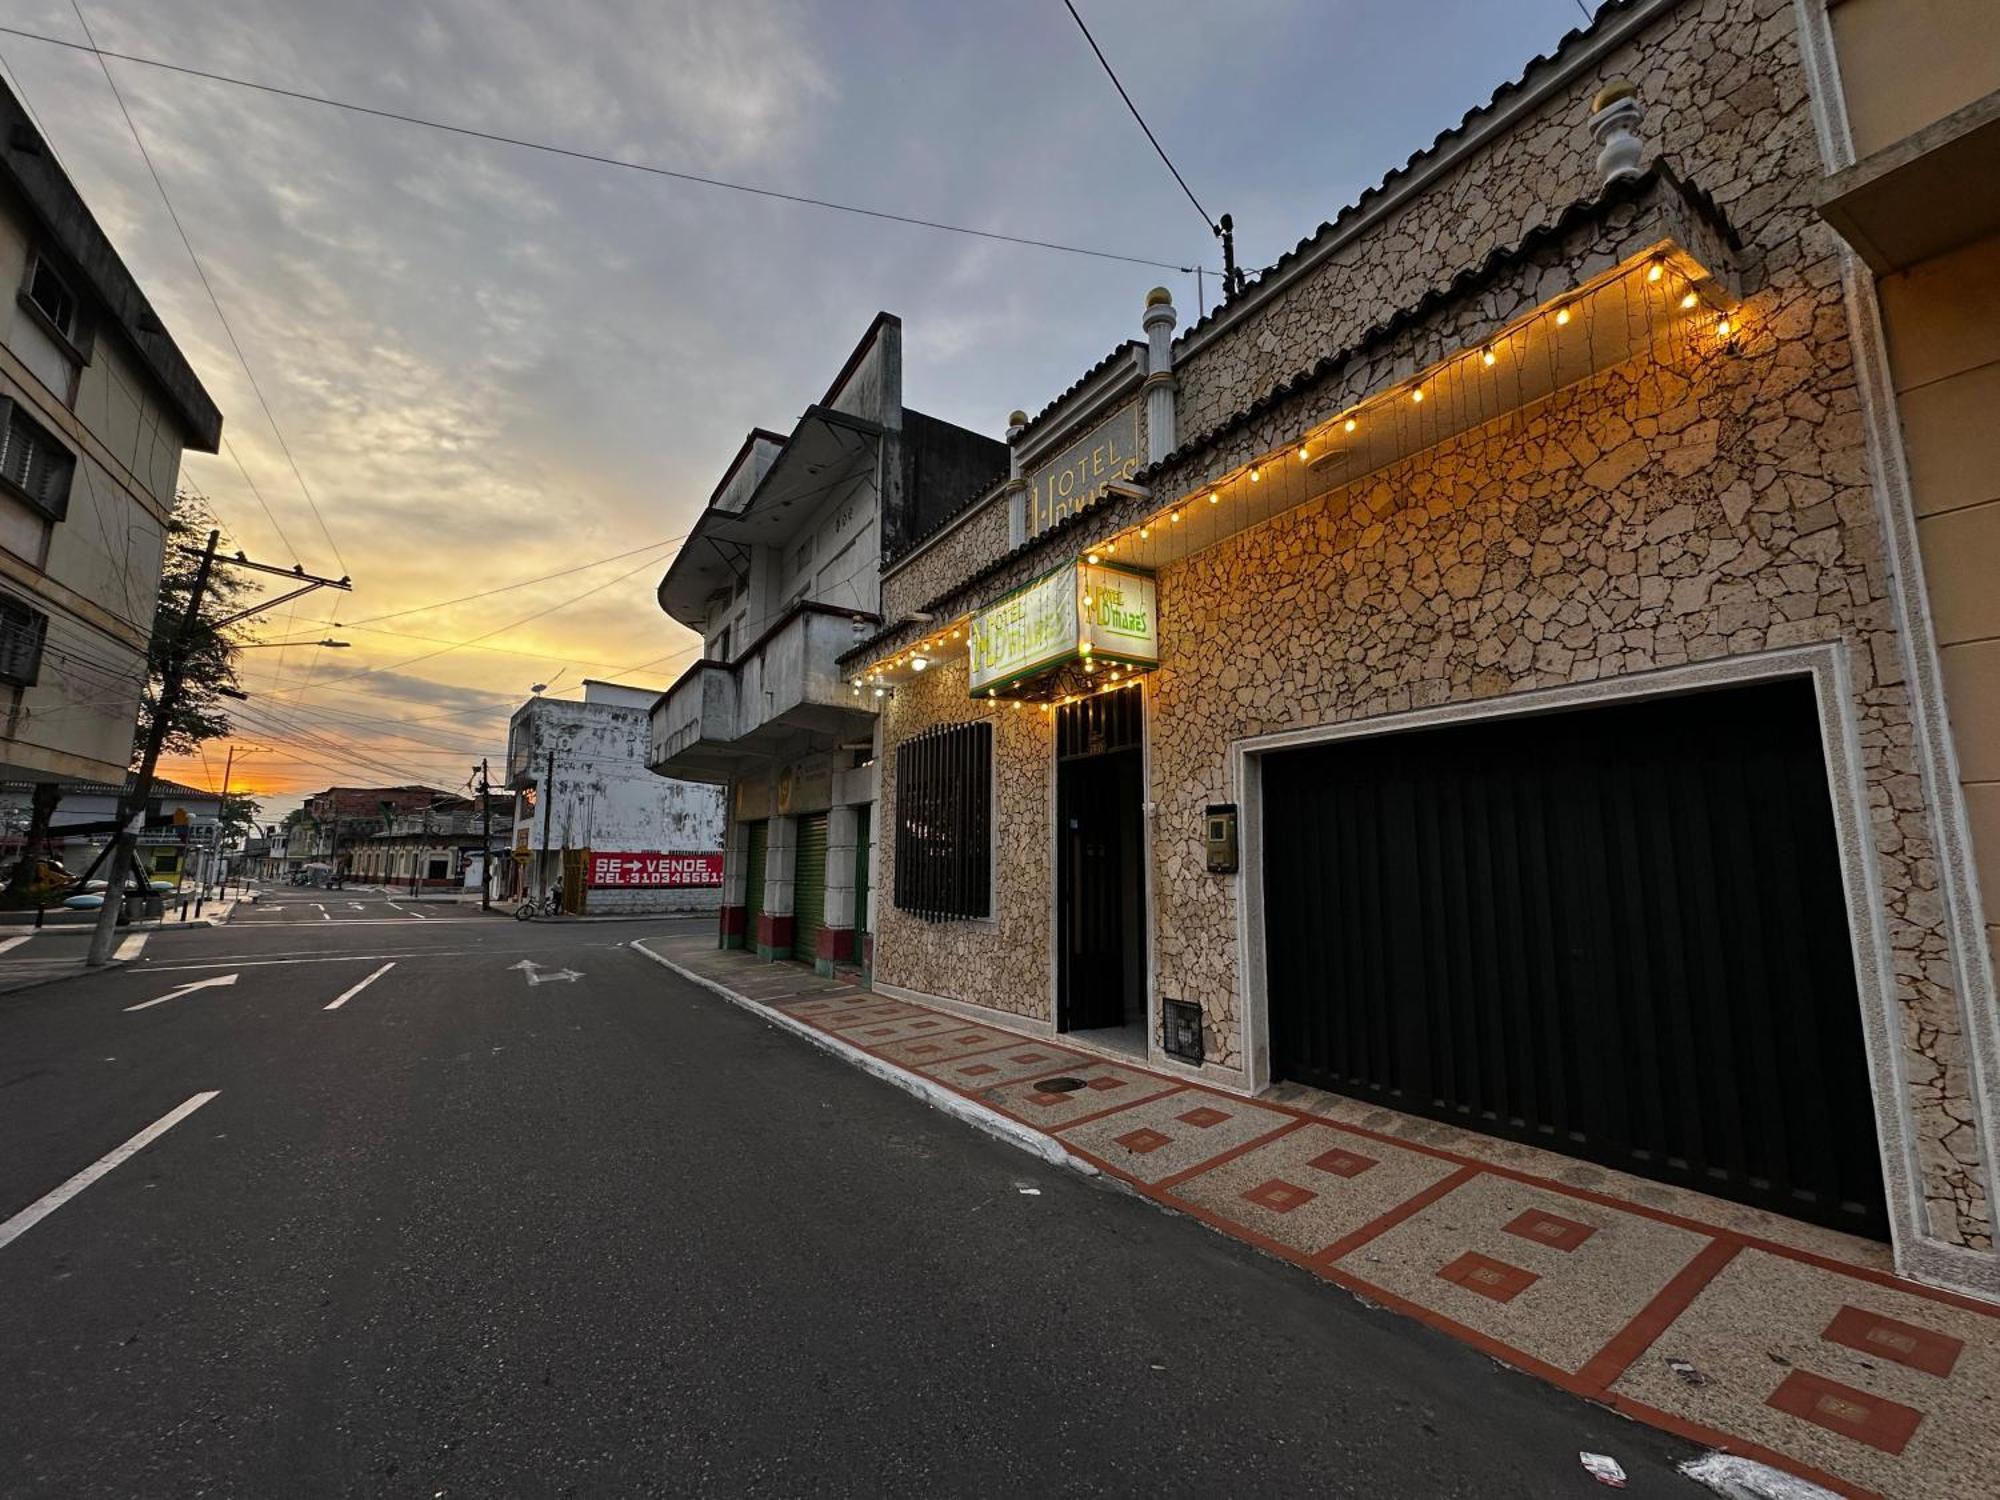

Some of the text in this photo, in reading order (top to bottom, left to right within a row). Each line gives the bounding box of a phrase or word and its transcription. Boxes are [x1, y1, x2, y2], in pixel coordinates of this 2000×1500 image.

[1032, 440, 1121, 537] HOTEL
[1088, 586, 1125, 625] HOTEL
[973, 607, 1025, 673] HOTEL
[595, 858, 622, 873] SE
